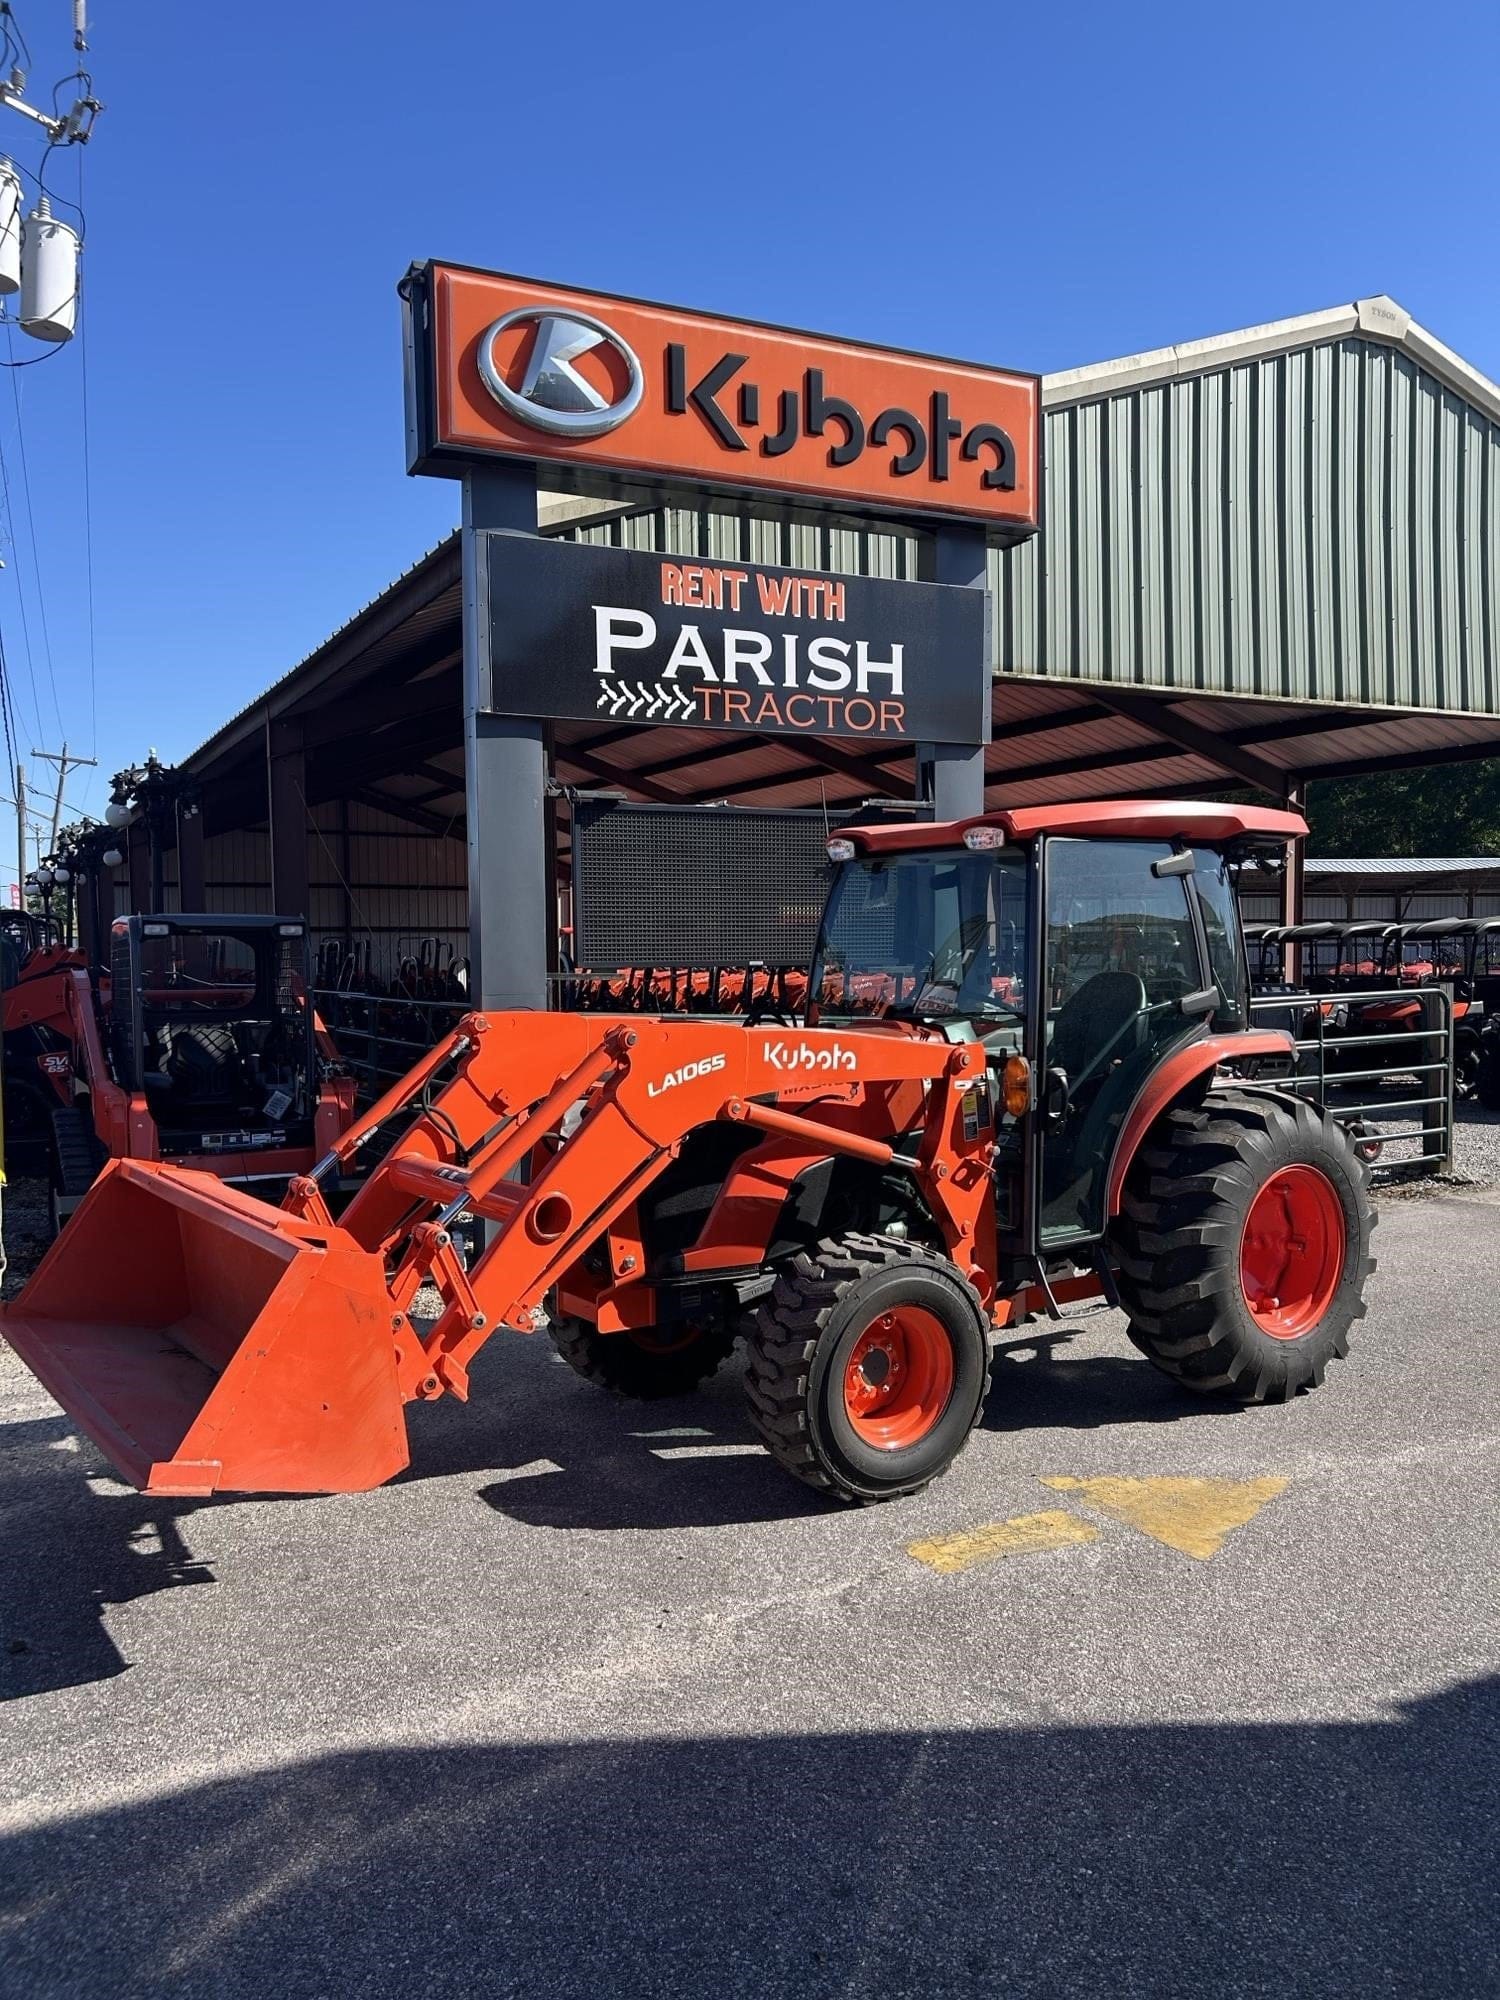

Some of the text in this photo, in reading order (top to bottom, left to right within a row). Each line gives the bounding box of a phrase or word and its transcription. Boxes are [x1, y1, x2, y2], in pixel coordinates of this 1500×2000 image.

[665, 342, 1016, 491] Kubota
[661, 562, 846, 622] RENT WITH
[591, 605, 905, 696] PARISH
[692, 685, 906, 733] TRACTOR
[647, 1053, 727, 1098] LA1065
[763, 1041, 857, 1071] Kubota
